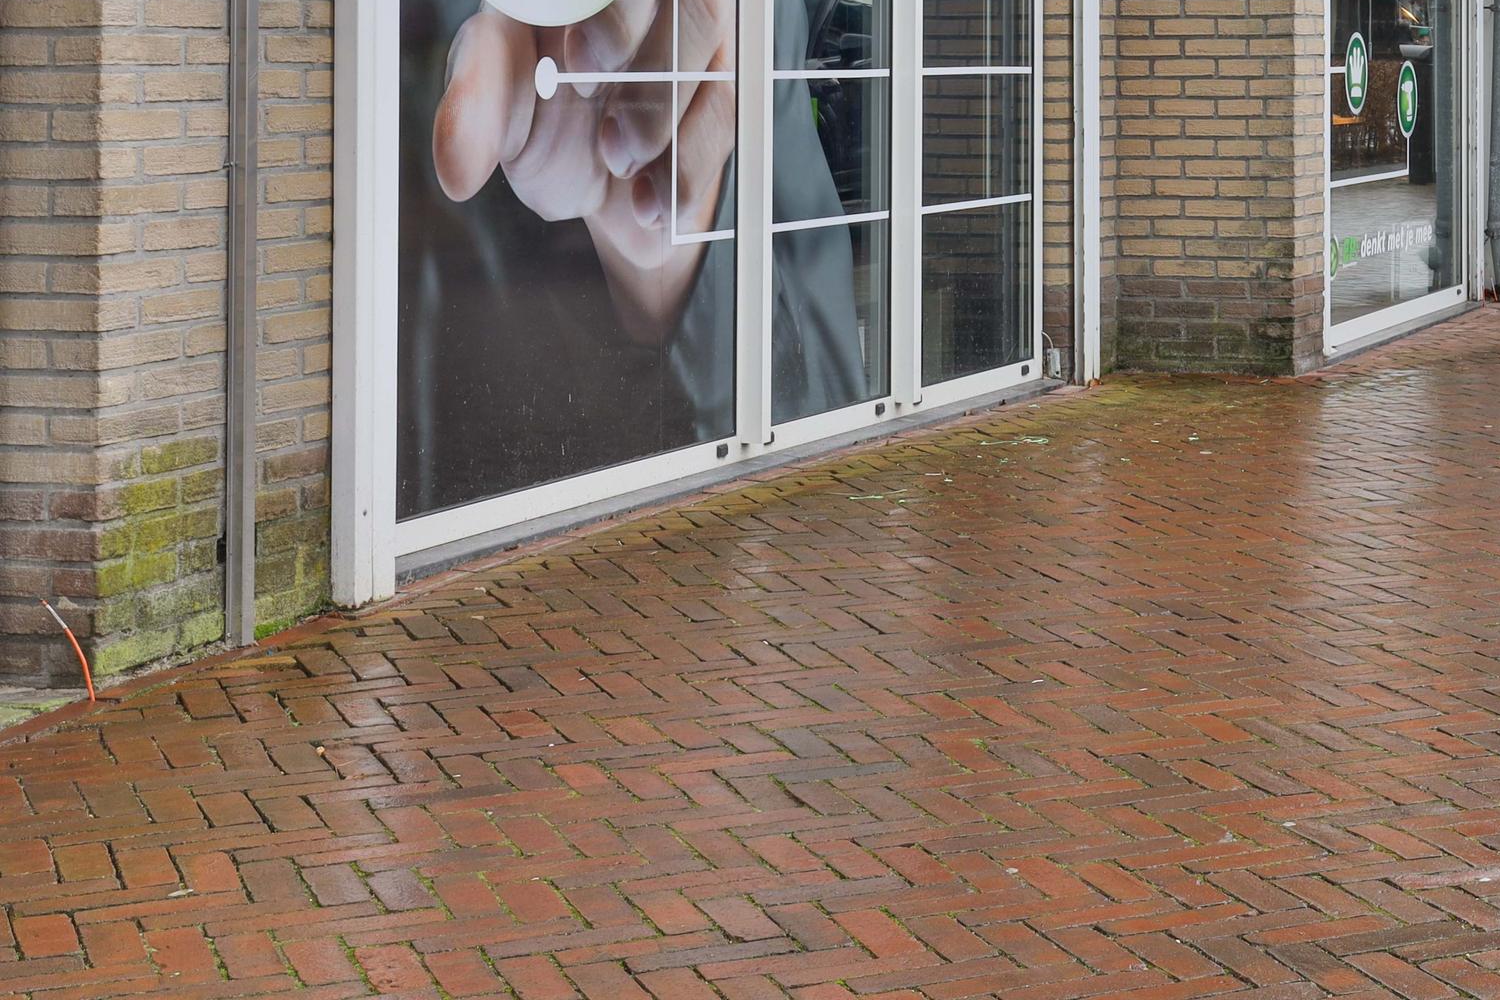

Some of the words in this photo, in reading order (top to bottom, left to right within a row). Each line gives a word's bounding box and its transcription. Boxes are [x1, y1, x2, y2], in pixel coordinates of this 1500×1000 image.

[1360, 231, 1386, 258] denkt
[1387, 226, 1404, 252] met
[1405, 224, 1414, 252] je
[1415, 224, 1433, 244] mee
